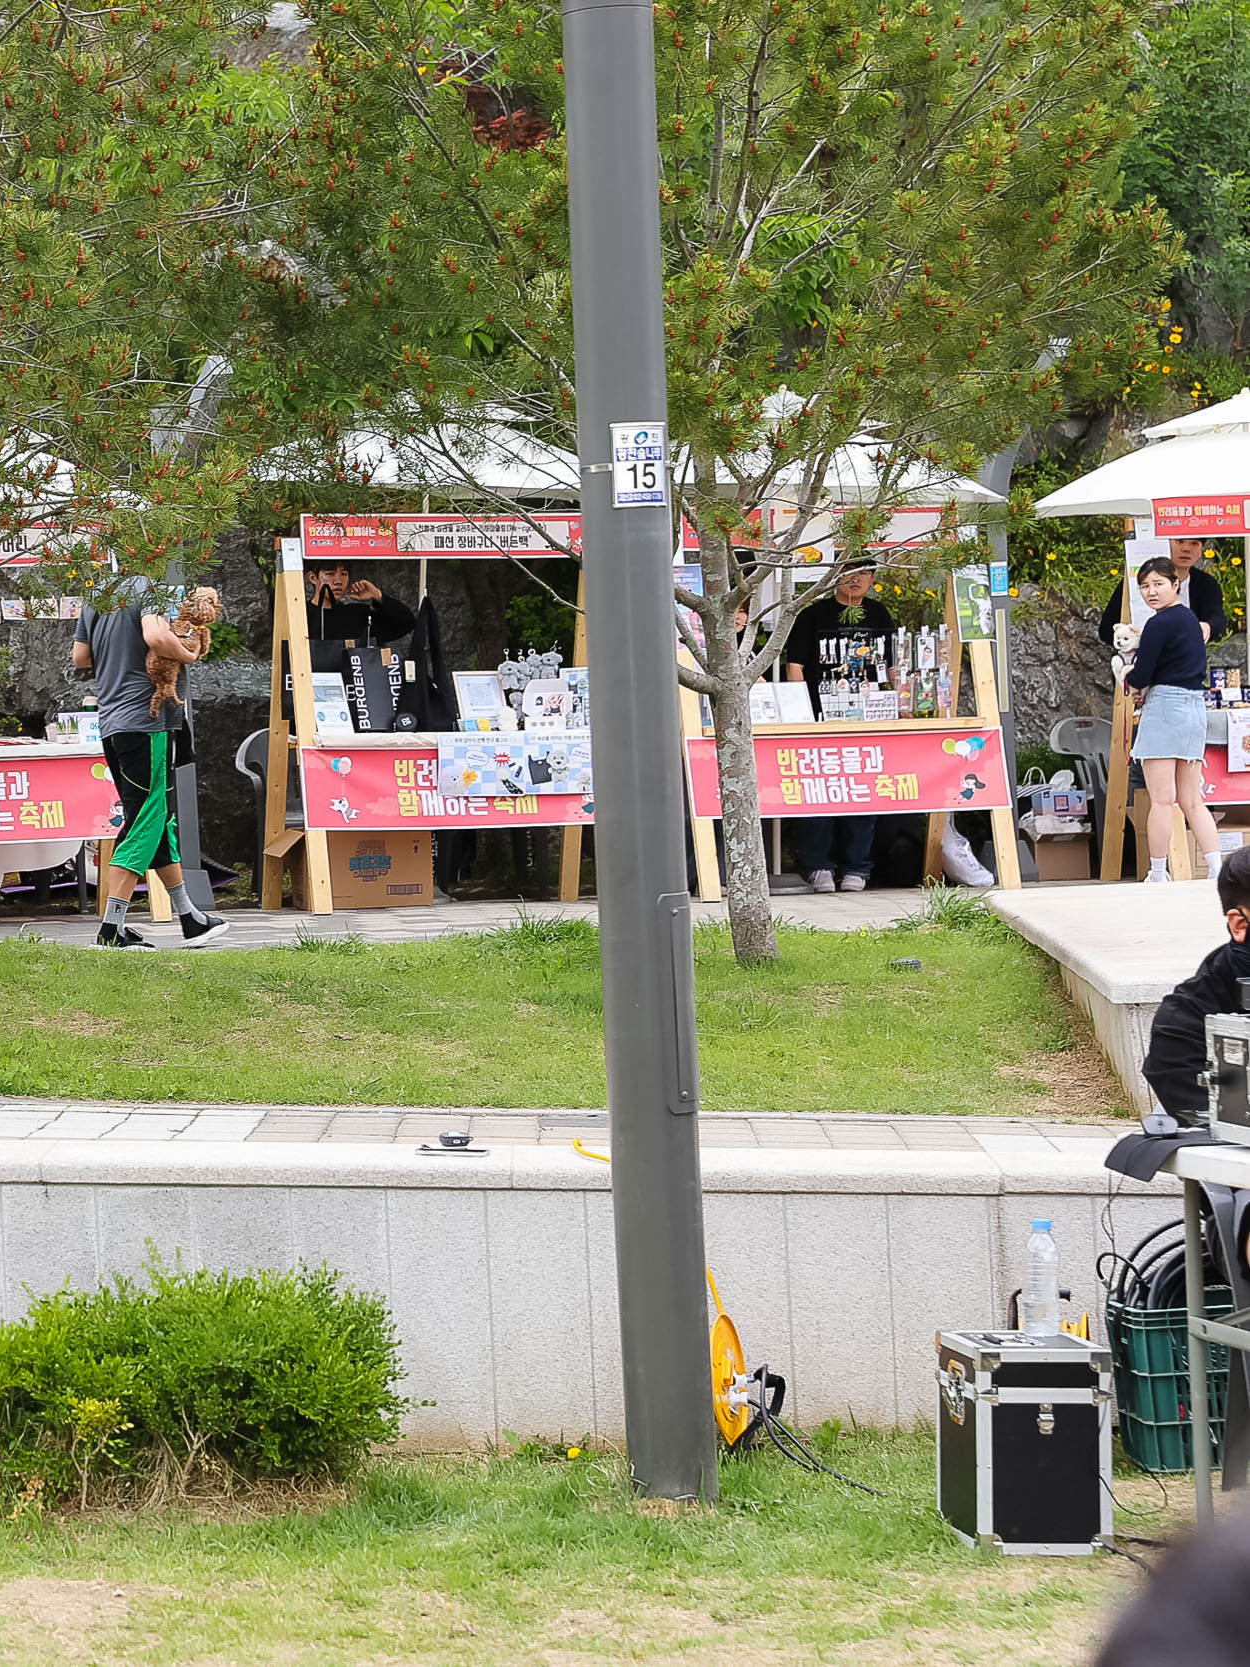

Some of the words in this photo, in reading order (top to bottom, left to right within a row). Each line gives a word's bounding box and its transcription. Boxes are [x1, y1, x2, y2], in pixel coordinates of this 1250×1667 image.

[626, 463, 656, 489] 15
[433, 535, 454, 548] 패션
[457, 535, 494, 548] 장바구니
[776, 745, 884, 776] 반려동물과
[779, 776, 871, 805] 함께하는
[874, 773, 920, 801] 축제
[18, 800, 66, 830] 축제
